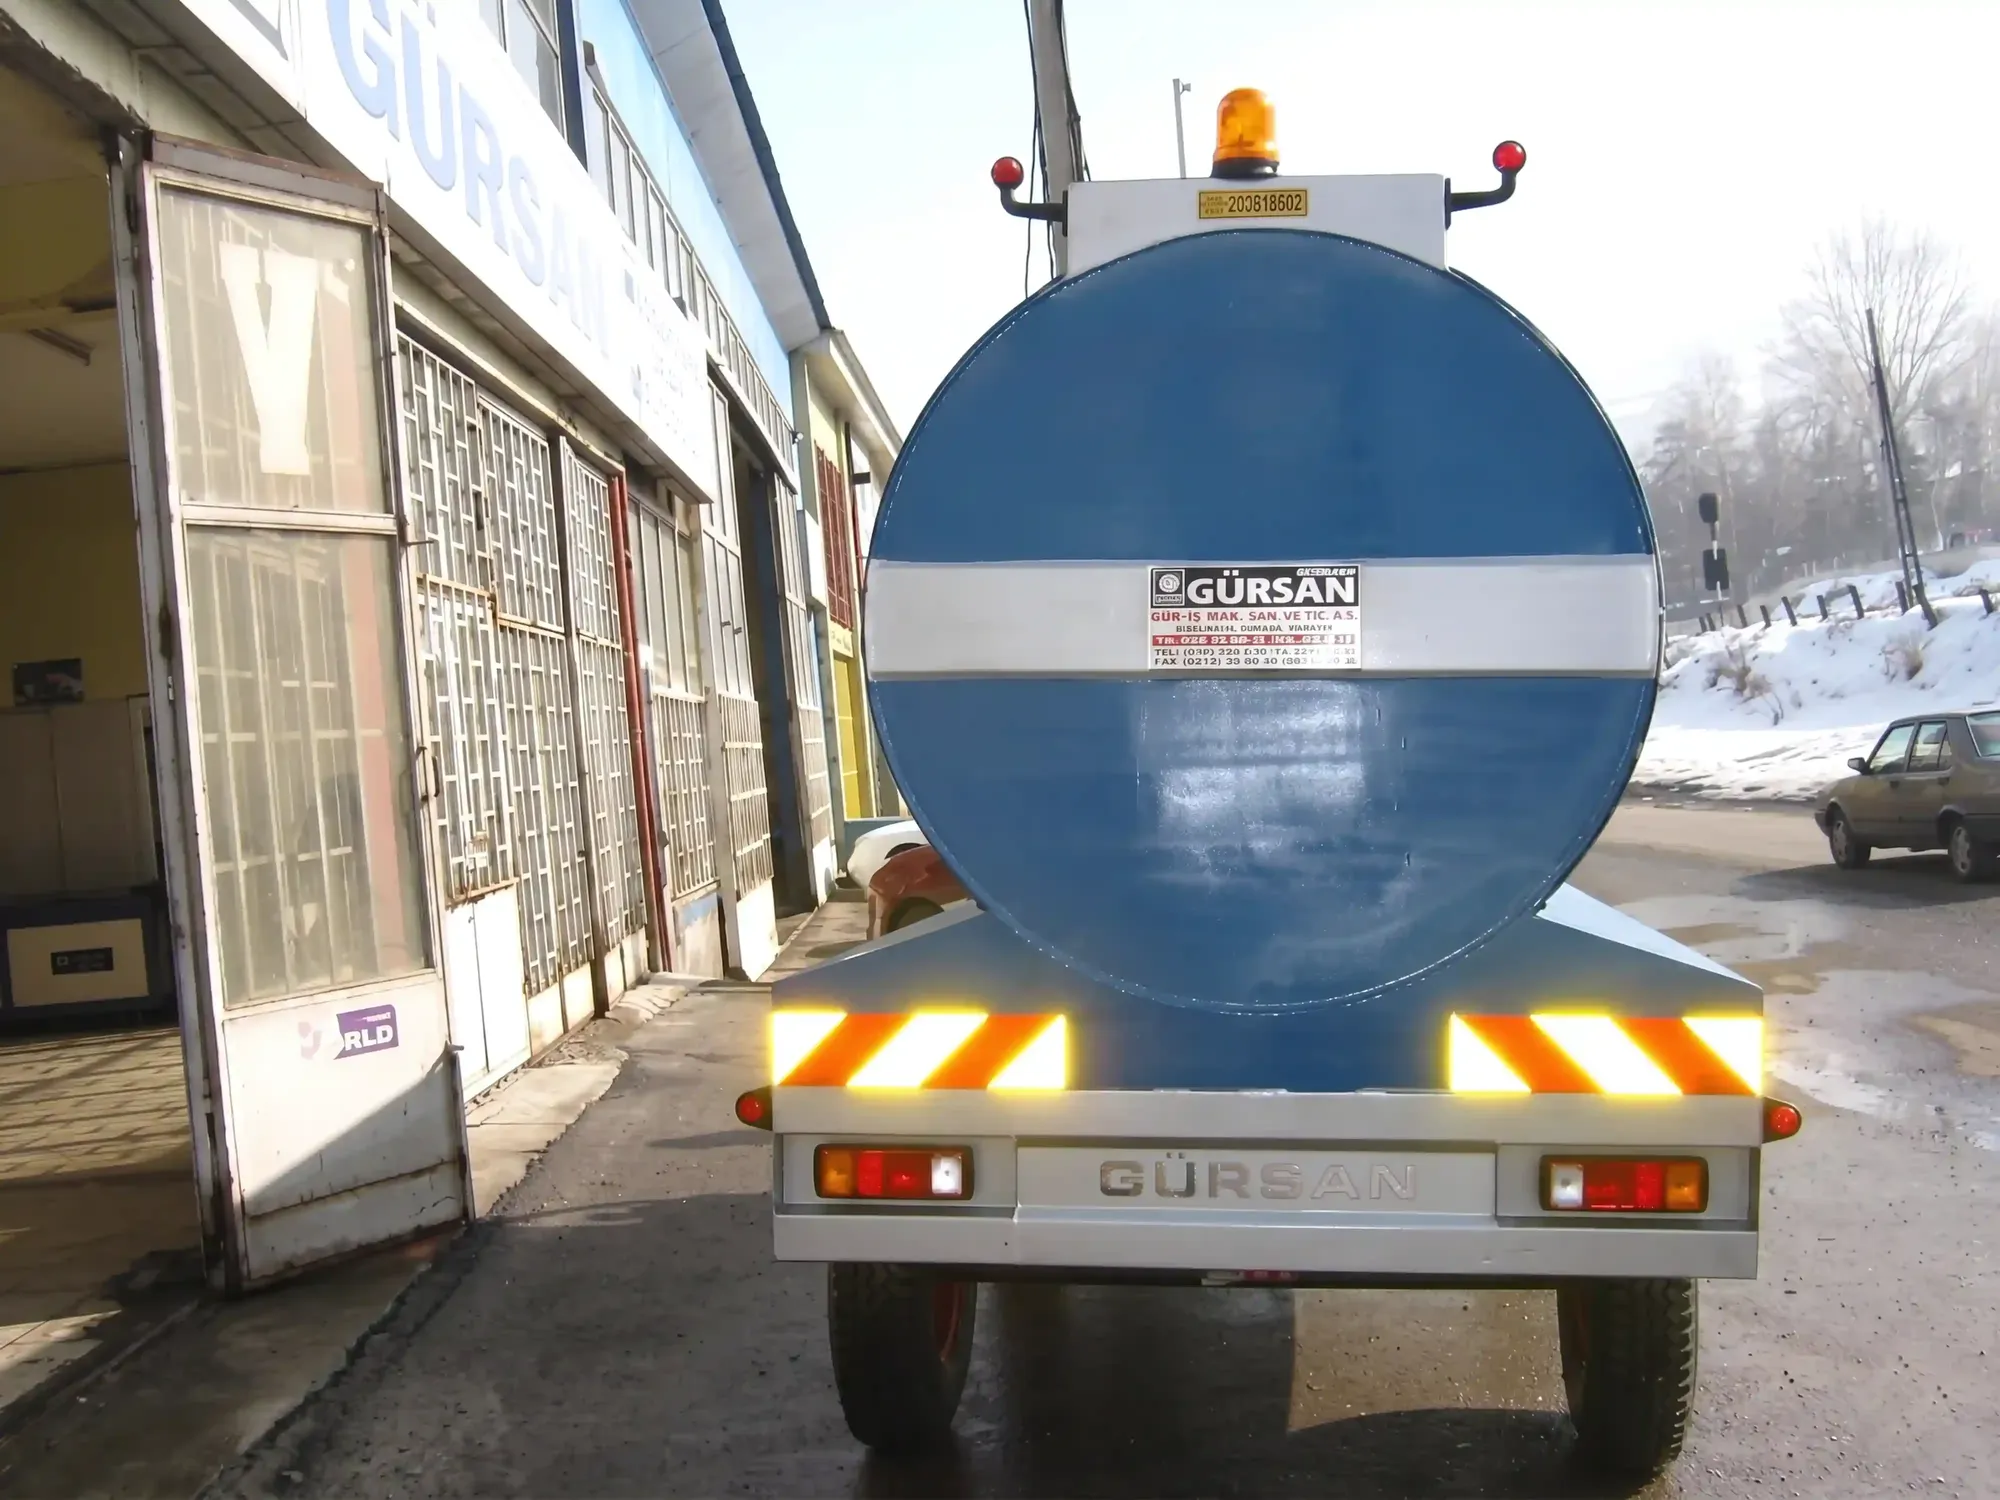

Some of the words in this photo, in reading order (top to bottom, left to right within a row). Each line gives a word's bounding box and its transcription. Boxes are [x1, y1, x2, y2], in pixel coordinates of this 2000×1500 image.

[1187, 570, 1355, 605] GÜRSAN
[1207, 612, 1243, 621] MAK.
[1100, 1152, 1416, 1200] GÜRSAN
